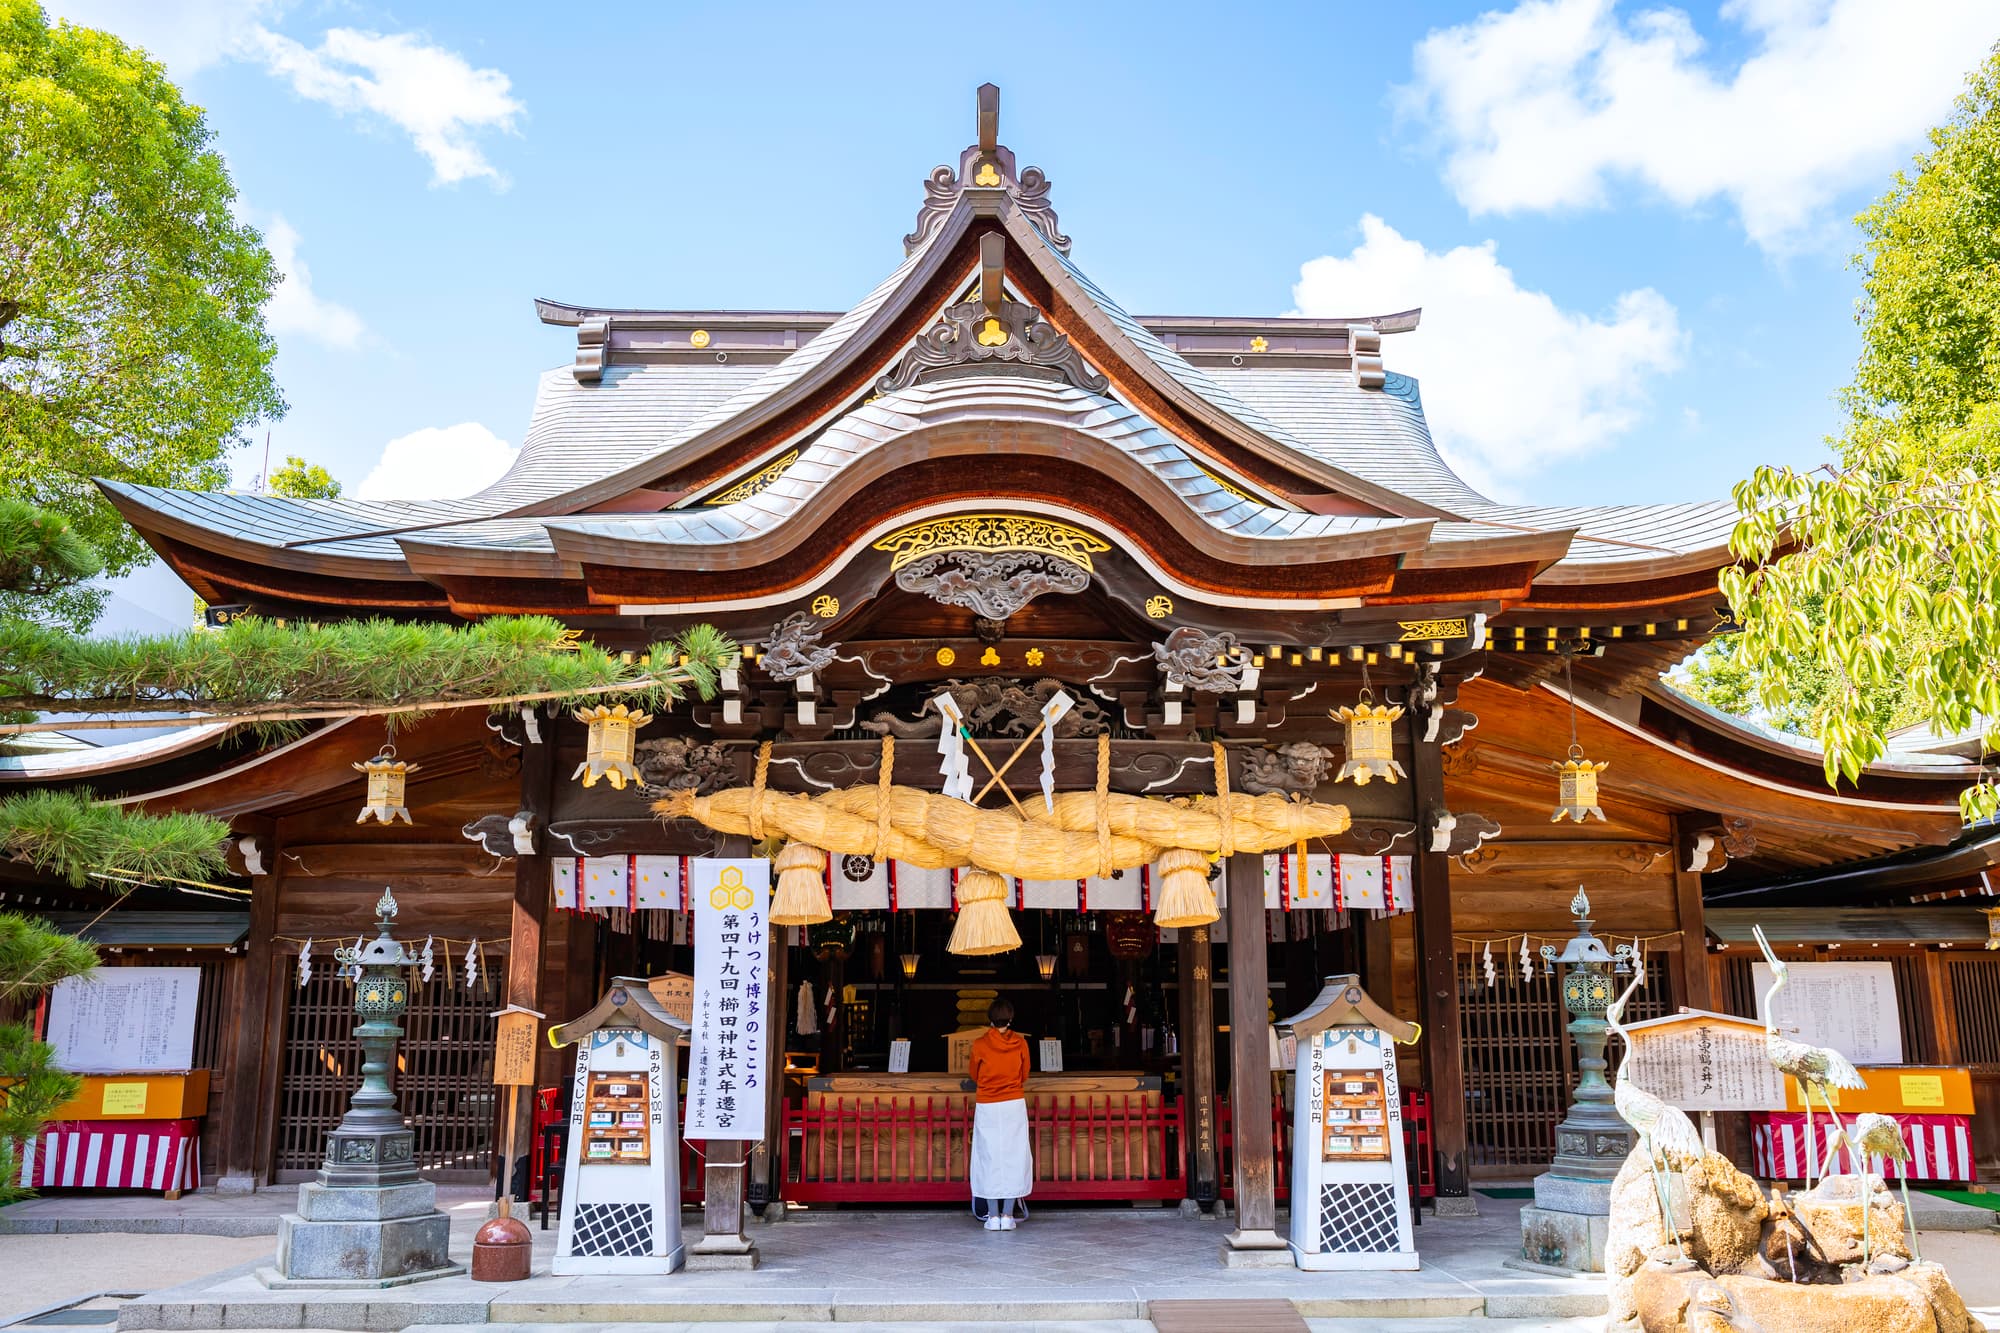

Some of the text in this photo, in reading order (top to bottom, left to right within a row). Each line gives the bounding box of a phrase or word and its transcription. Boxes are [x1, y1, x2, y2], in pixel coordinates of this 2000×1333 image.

[744, 912, 762, 1089] うけつぐ博多のこころ
[572, 1050, 589, 1125] おみくじ100円
[649, 1050, 663, 1125] おみくじ100円
[1310, 1048, 1323, 1124] おみくじ100円
[1383, 1047, 1400, 1122] おみくじ100円
